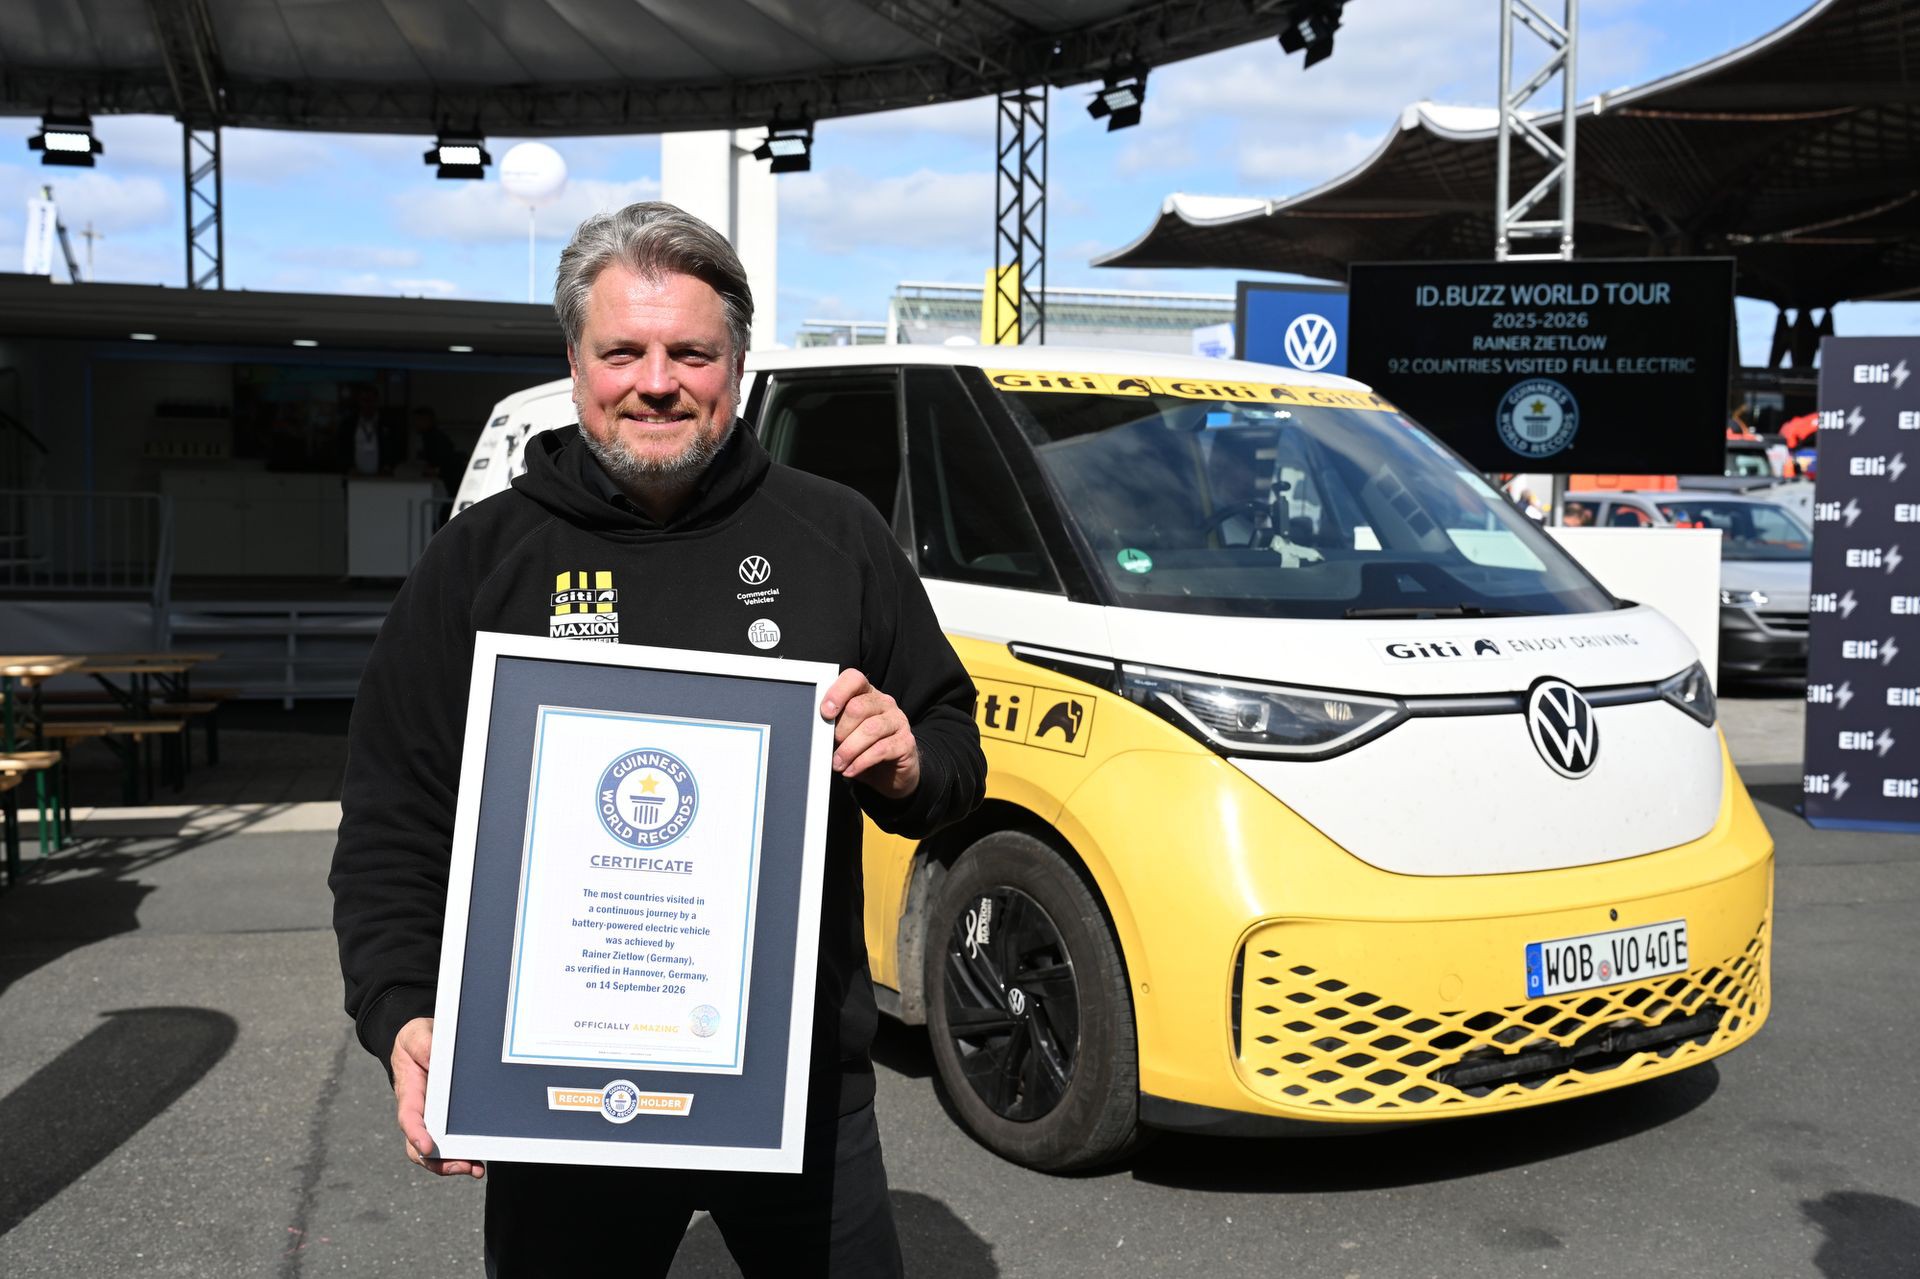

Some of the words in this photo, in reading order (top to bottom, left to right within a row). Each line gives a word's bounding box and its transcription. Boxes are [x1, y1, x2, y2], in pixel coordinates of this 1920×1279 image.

[1416, 285, 1506, 307] ID.BUZZ
[1510, 283, 1599, 306] WORLD
[1603, 282, 1671, 305] TOUR
[1492, 312, 1589, 329] 2025-2026
[1472, 335, 1531, 351] RAINER
[1533, 335, 1607, 351] ZIETLOW
[1388, 358, 1409, 374] 92
[1412, 358, 1502, 374] COUNTRIES
[1504, 358, 1568, 374] VISITED
[1573, 358, 1613, 374] FULL
[1616, 357, 1696, 374] ELECTRIC
[1853, 363, 1890, 383] Elli
[993, 374, 1097, 391] Giti
[1171, 382, 1258, 399] Giti
[1508, 384, 1567, 404] GUINNESS
[1502, 413, 1528, 451] WORLD
[1530, 413, 1574, 453] RECORDS
[1850, 456, 1886, 476] Elli
[1846, 548, 1882, 568] Elli
[555, 591, 592, 603] Giti
[737, 588, 780, 600] Commercial
[744, 597, 775, 605] Vehicles
[1890, 596, 1920, 614] Ell
[550, 622, 619, 638] MAXION
[751, 622, 779, 643] ifm
[1385, 640, 1462, 659] Giti
[1507, 638, 1567, 652] ENJOY
[1569, 633, 1639, 649] DRIVING
[1842, 639, 1878, 660] Elli
[1839, 731, 1874, 750] Elli
[613, 754, 687, 783] GUINNESS
[1883, 778, 1919, 798] Elli
[602, 789, 633, 839] WORLD
[638, 795, 693, 844] RECORDS
[590, 855, 693, 873] CERTIFICATE
[583, 888, 598, 898] The
[601, 891, 622, 900] most
[624, 892, 664, 902] countries
[666, 895, 695, 905] visited
[696, 897, 705, 906] in
[596, 904, 644, 916] continuous
[646, 908, 678, 920] journey
[680, 910, 689, 921] by
[691, 912, 697, 920] a
[572, 918, 643, 931] battery-powered
[645, 923, 678, 934] electric
[680, 926, 710, 936] vehicle
[605, 937, 622, 945] was
[624, 938, 663, 948] achieved
[665, 940, 675, 950] by
[582, 948, 611, 959] Rainer
[612, 951, 645, 961] Zietlow
[647, 953, 695, 966] (Germany),
[1531, 976, 1539, 988] D
[1545, 944, 1594, 987] WOB
[577, 964, 610, 975] verified
[612, 966, 621, 975] in
[622, 967, 666, 979] Hannover,
[668, 970, 709, 982] Germany,
[586, 981, 597, 989] on
[600, 980, 611, 990] 14
[613, 981, 661, 993] September
[662, 984, 686, 995] 2026
[574, 1020, 630, 1031] OFFICIALLY
[633, 1023, 680, 1033] AMAZING
[608, 1085, 634, 1096] GUINNESS
[559, 1094, 601, 1105] RECORD
[640, 1097, 682, 1108] HOLDER
